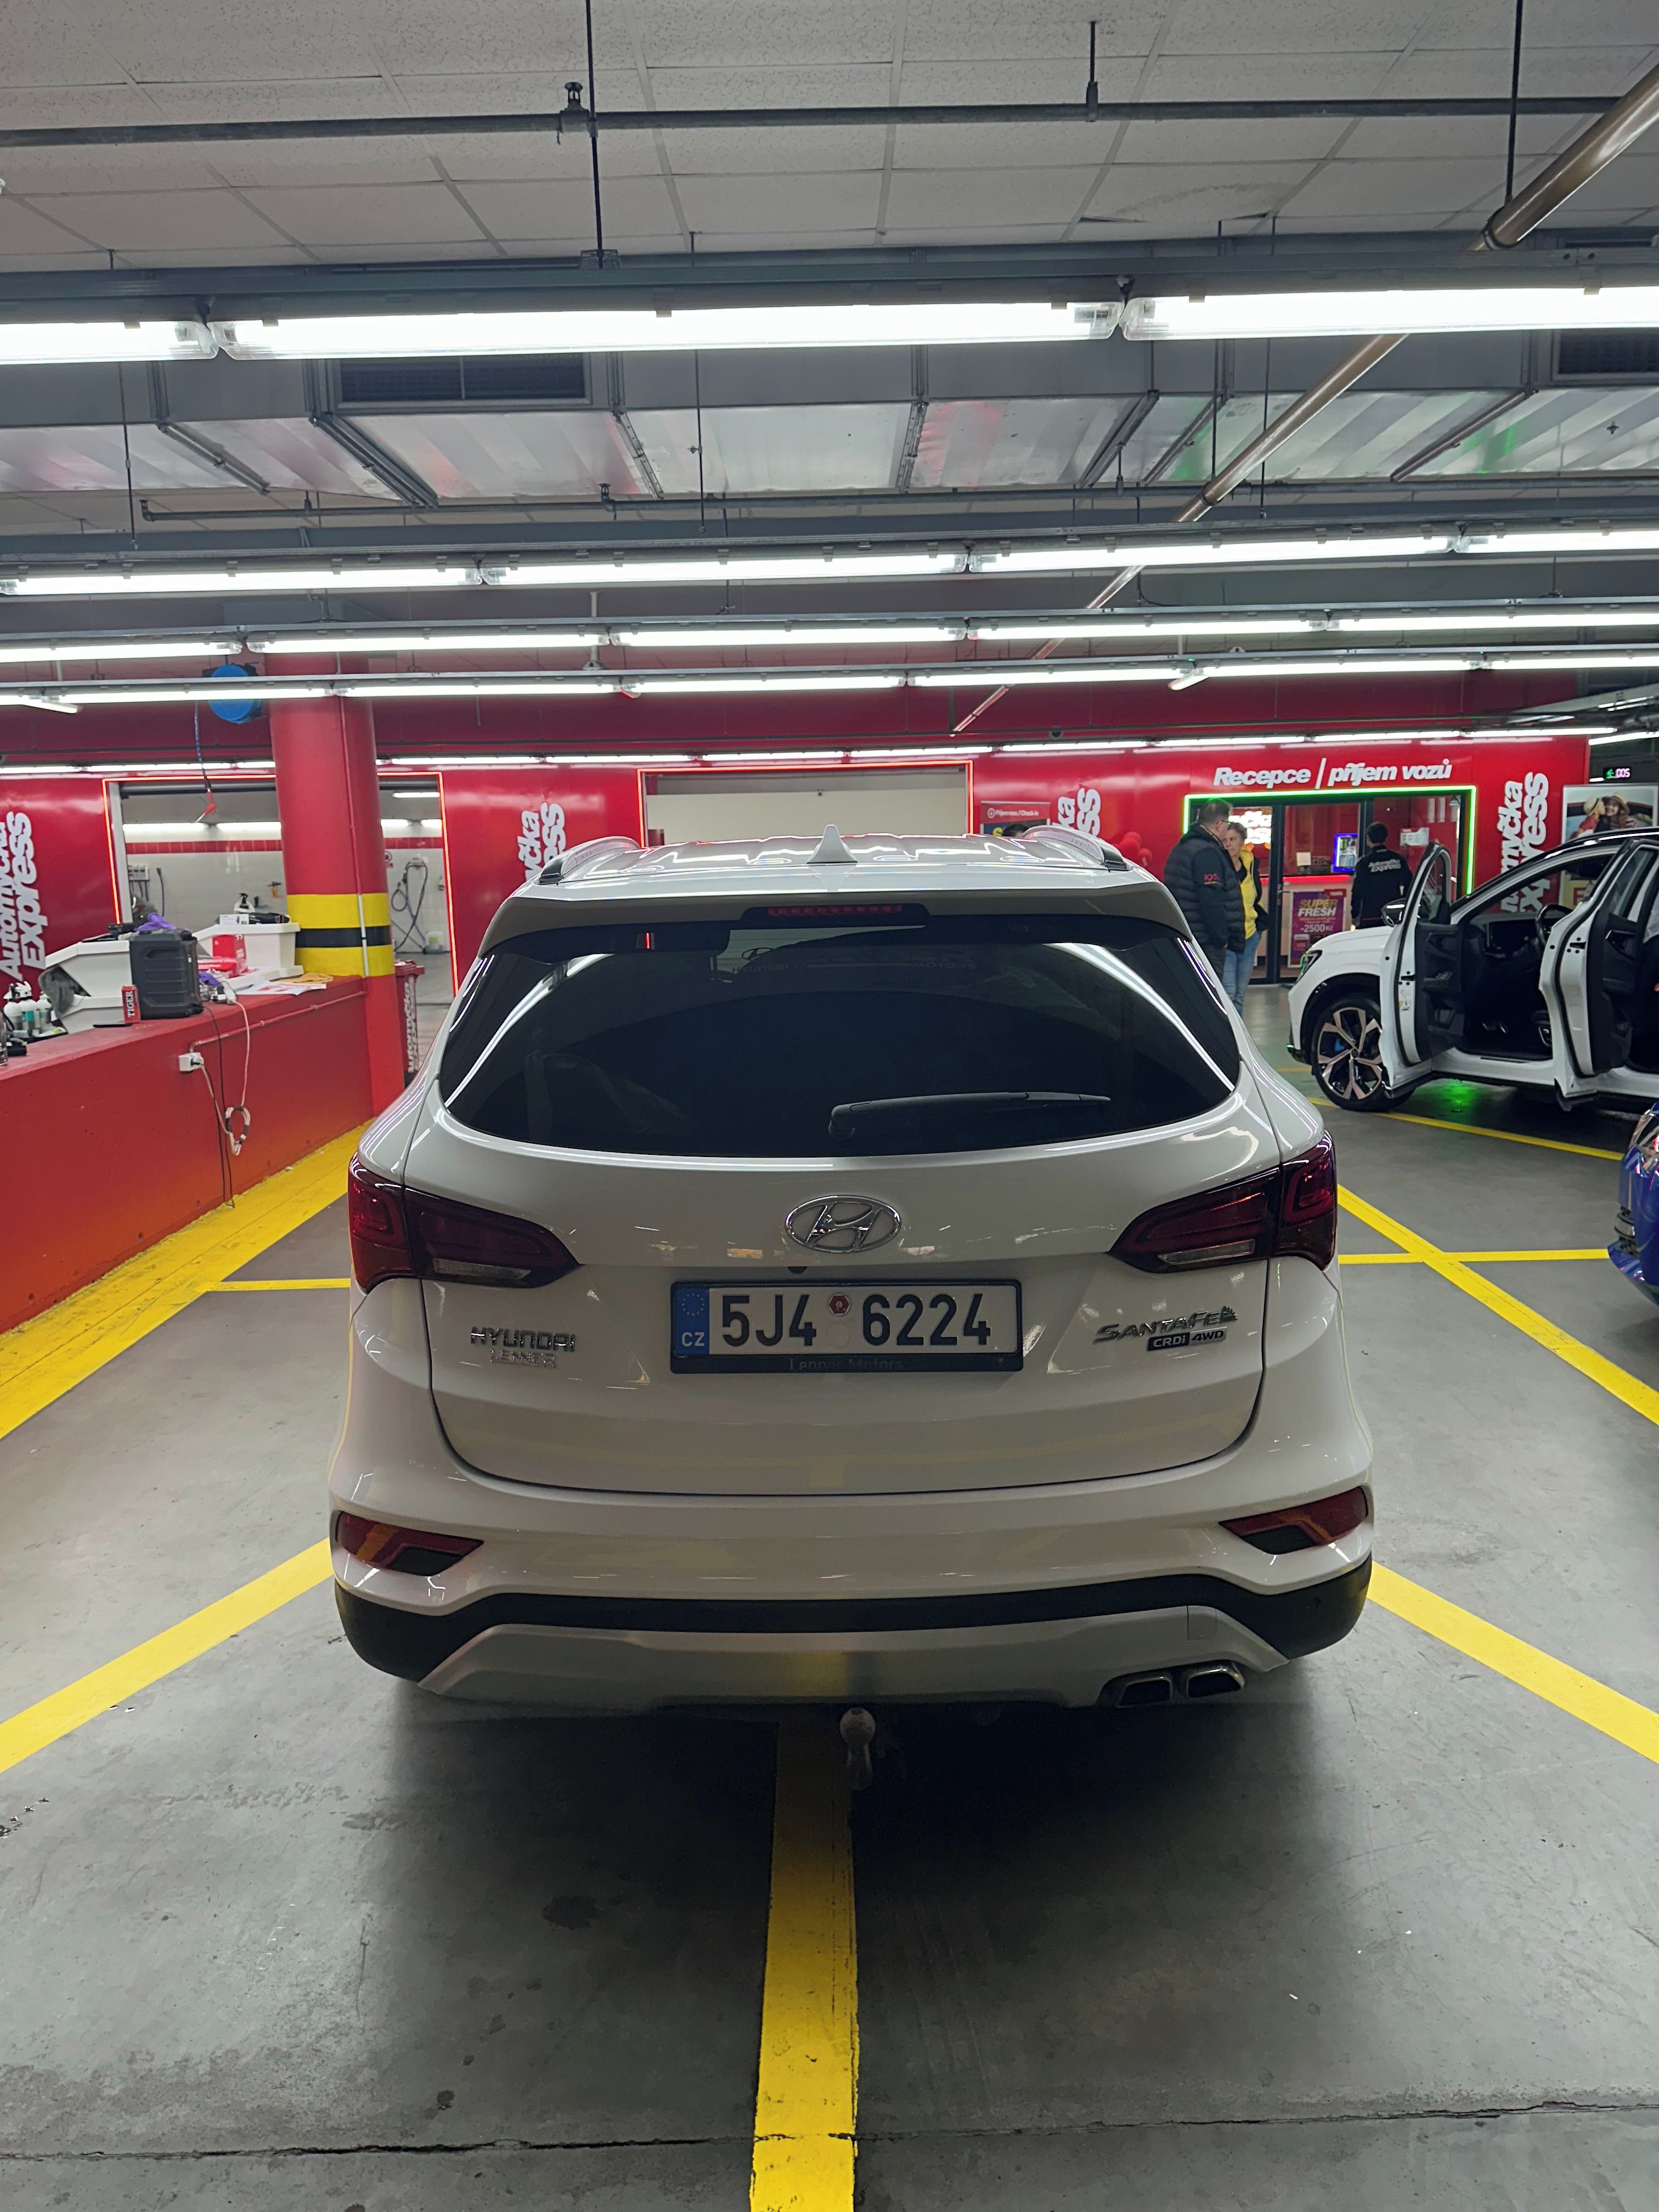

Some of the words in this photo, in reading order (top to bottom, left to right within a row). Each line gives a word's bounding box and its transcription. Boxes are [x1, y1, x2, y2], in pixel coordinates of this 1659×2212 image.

[1213, 766, 1311, 789] Recepce
[1327, 762, 1397, 786] příjem
[1402, 758, 1453, 780] vozů
[6, 811, 48, 970] Express
[1298, 907, 1337, 917] FRESH
[1299, 899, 1338, 908] SUPER
[1300, 924, 1325, 933] -2500
[126, 991, 135, 1018] TIGER
[721, 1294, 817, 1347] 5J4
[862, 1294, 991, 1346] 6224
[470, 1326, 575, 1352] HYUNDAI
[681, 1331, 705, 1347] CZ
[1153, 1335, 1186, 1347] CRDi
[1191, 1330, 1224, 1341] 4WD
